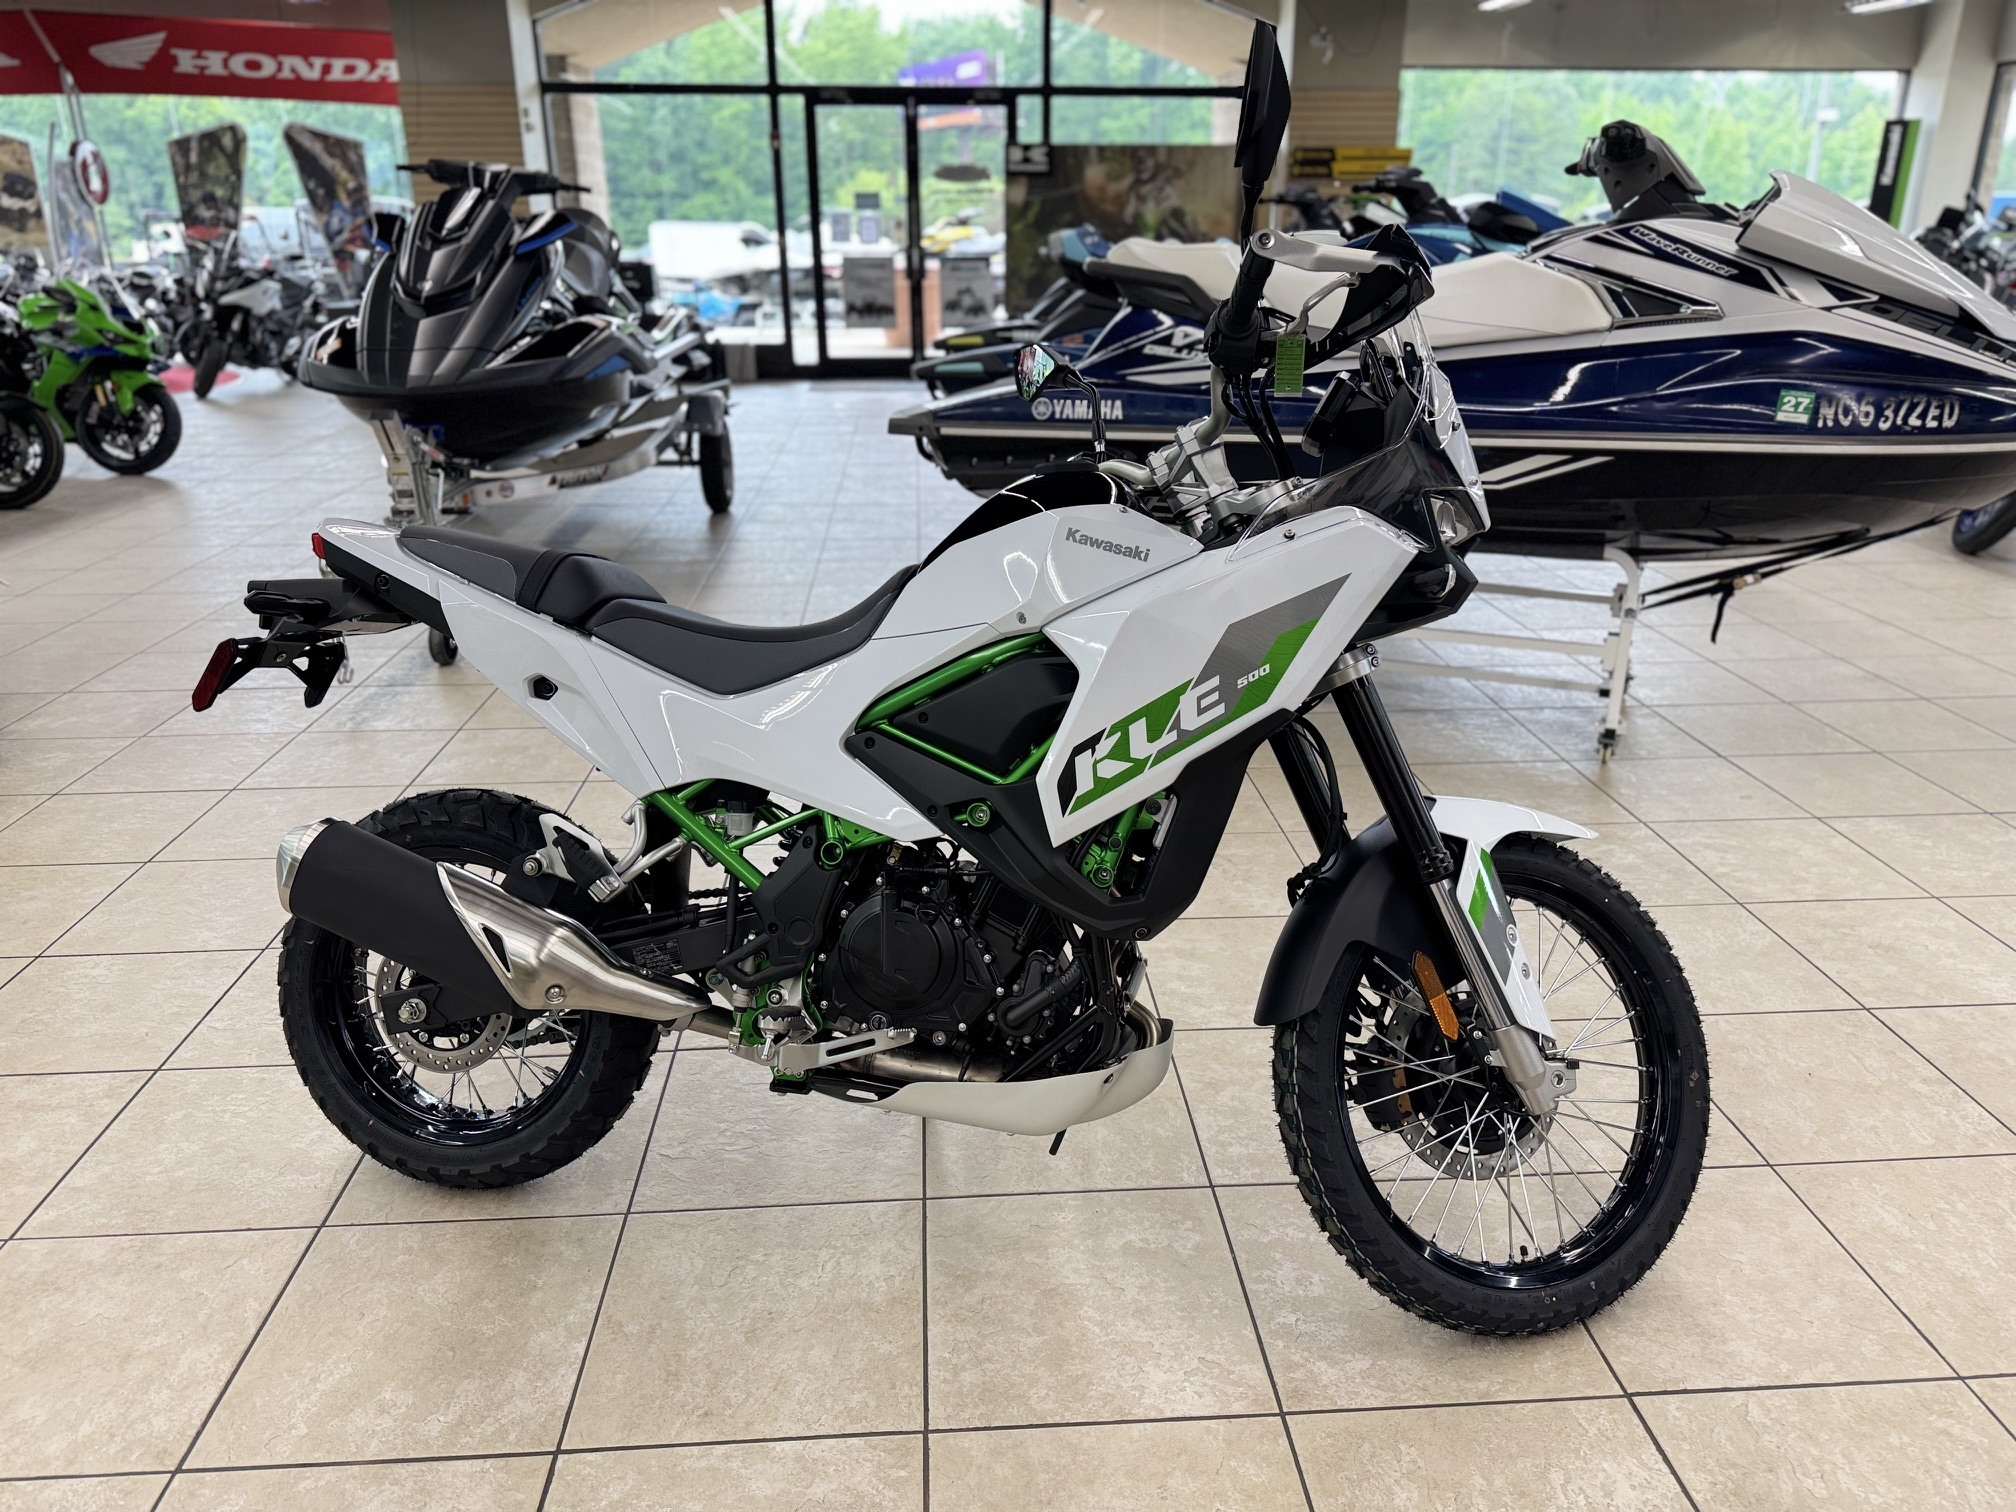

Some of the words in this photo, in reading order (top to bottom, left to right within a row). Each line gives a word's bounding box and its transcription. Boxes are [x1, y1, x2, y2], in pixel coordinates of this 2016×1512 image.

[170, 48, 400, 83] HONDA
[1629, 226, 1739, 276] WaveRunner
[1781, 396, 1811, 412] 27
[1065, 527, 1150, 562] Kawasaki
[1237, 663, 1270, 689] 500
[1075, 675, 1225, 796] KLE
